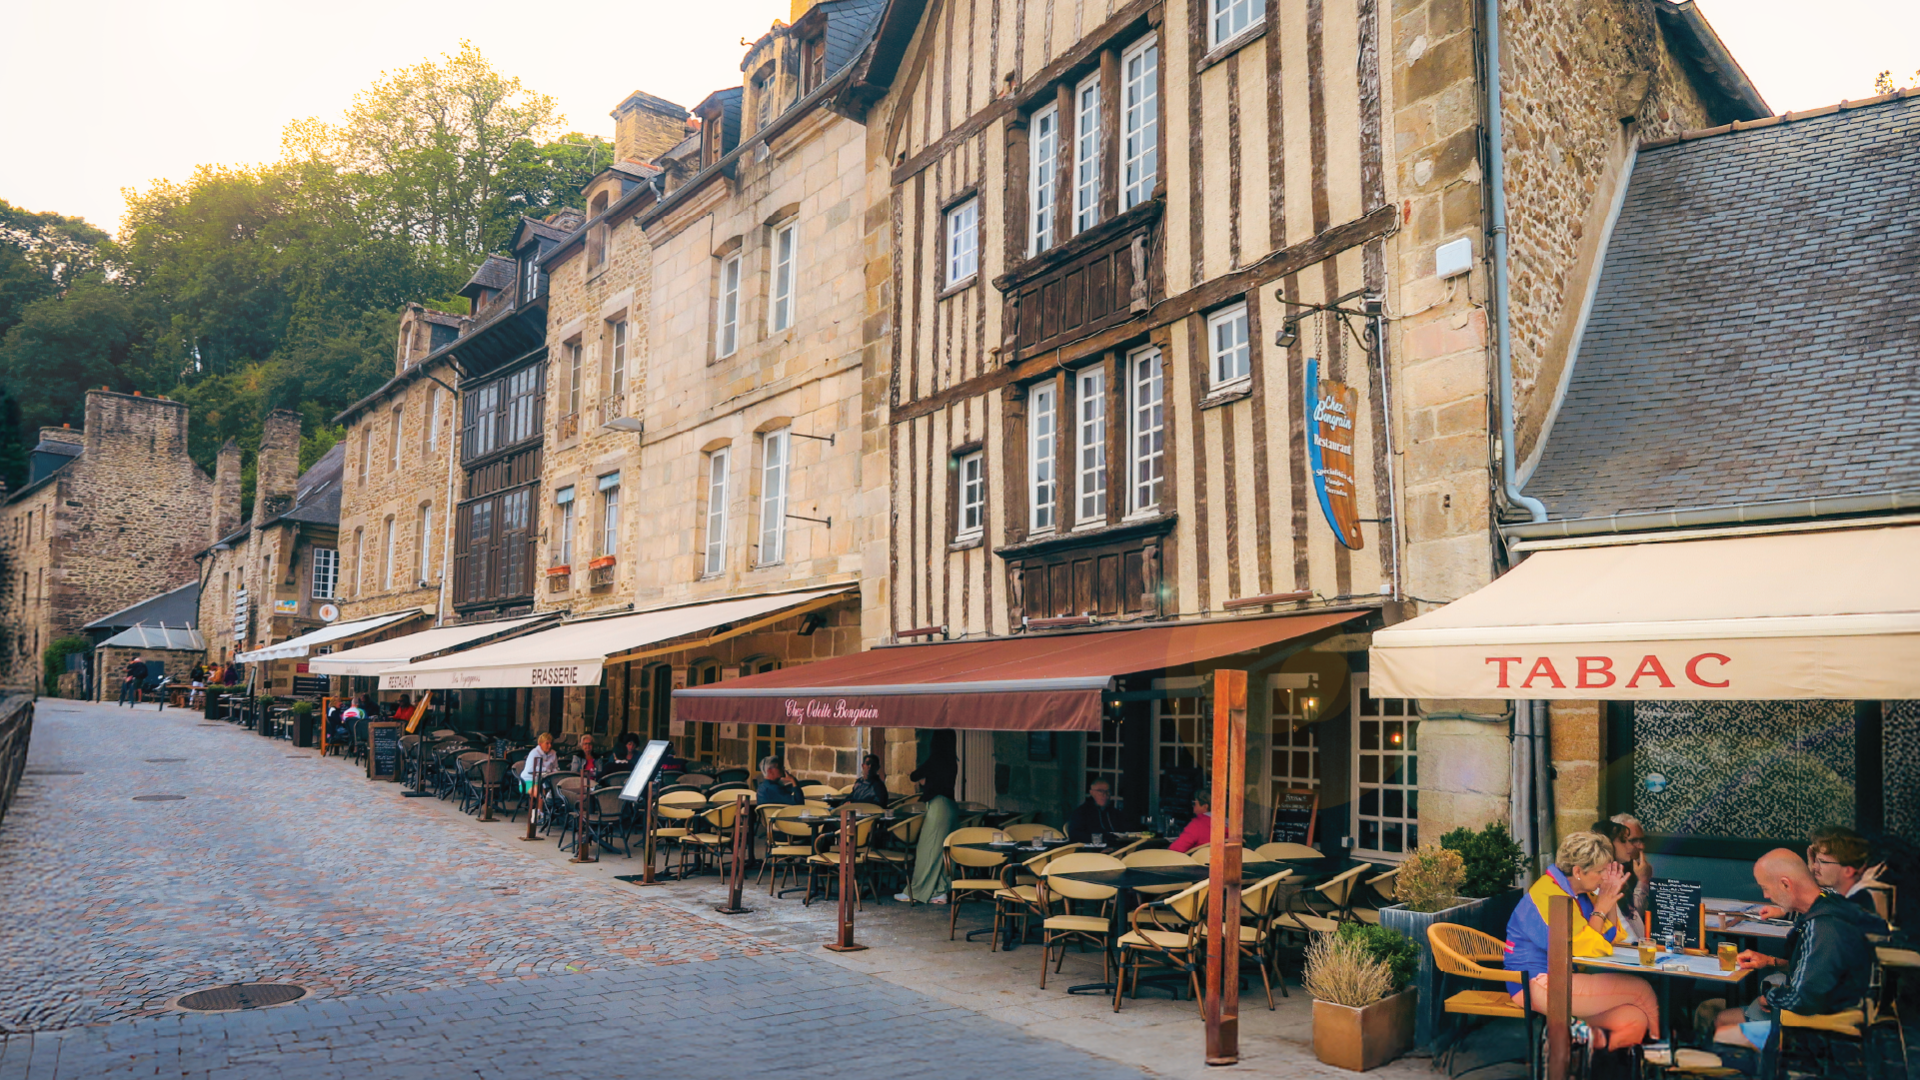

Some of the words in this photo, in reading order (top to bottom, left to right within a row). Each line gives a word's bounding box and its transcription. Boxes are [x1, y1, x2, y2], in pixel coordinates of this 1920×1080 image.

[1313, 400, 1352, 431] Bongrain
[1324, 395, 1346, 415] Chez
[1313, 434, 1352, 456] Restaurant
[388, 675, 416, 688] RESTAURANT
[532, 666, 578, 685] BRASSERIE
[1485, 652, 1732, 689] TABAC
[785, 698, 805, 725] Chez
[806, 698, 832, 719] Odette
[833, 698, 880, 727] Bongrain
